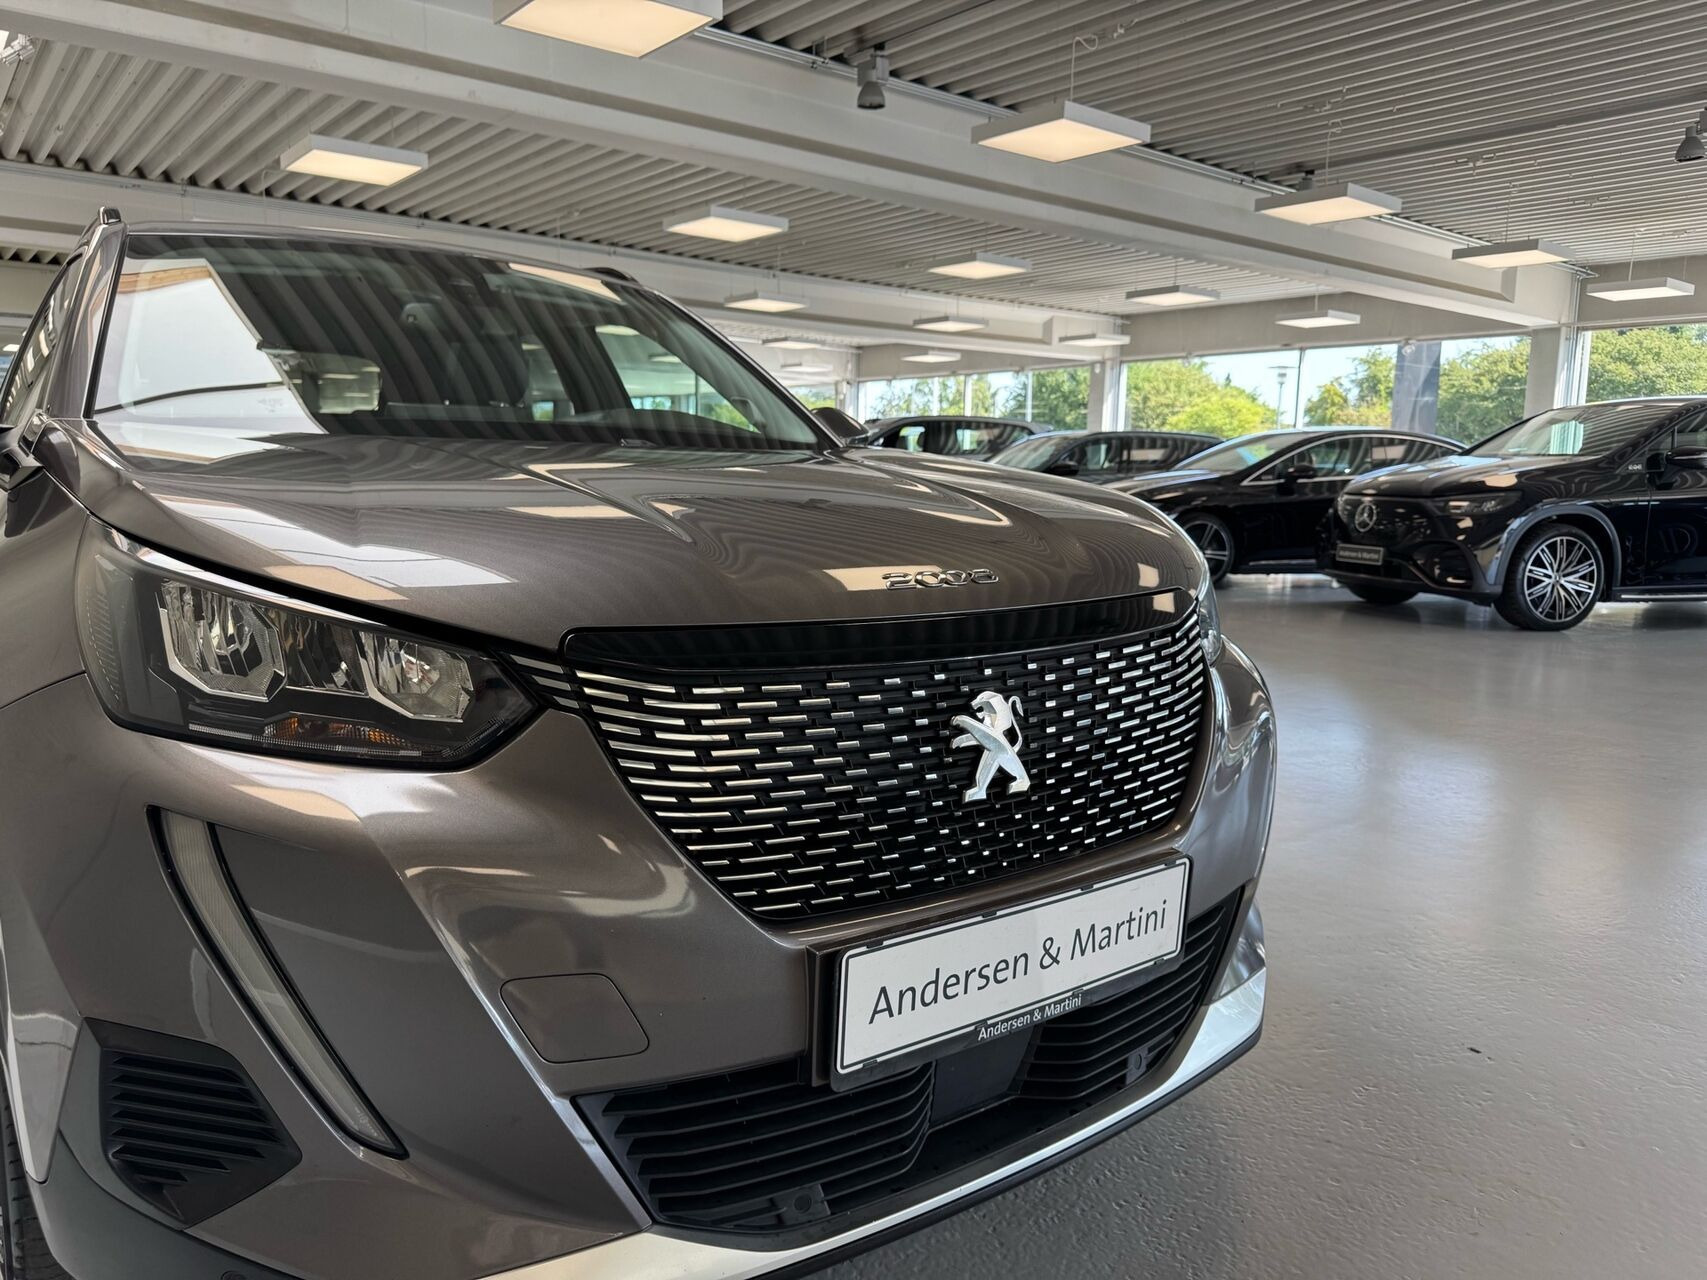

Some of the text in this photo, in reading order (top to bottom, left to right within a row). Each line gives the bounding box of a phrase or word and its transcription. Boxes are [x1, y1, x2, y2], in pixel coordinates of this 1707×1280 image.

[881, 568, 999, 590] 2008
[868, 899, 1168, 1024] Andersen & Martini
[978, 995, 1082, 1041] Andersen & Martini
